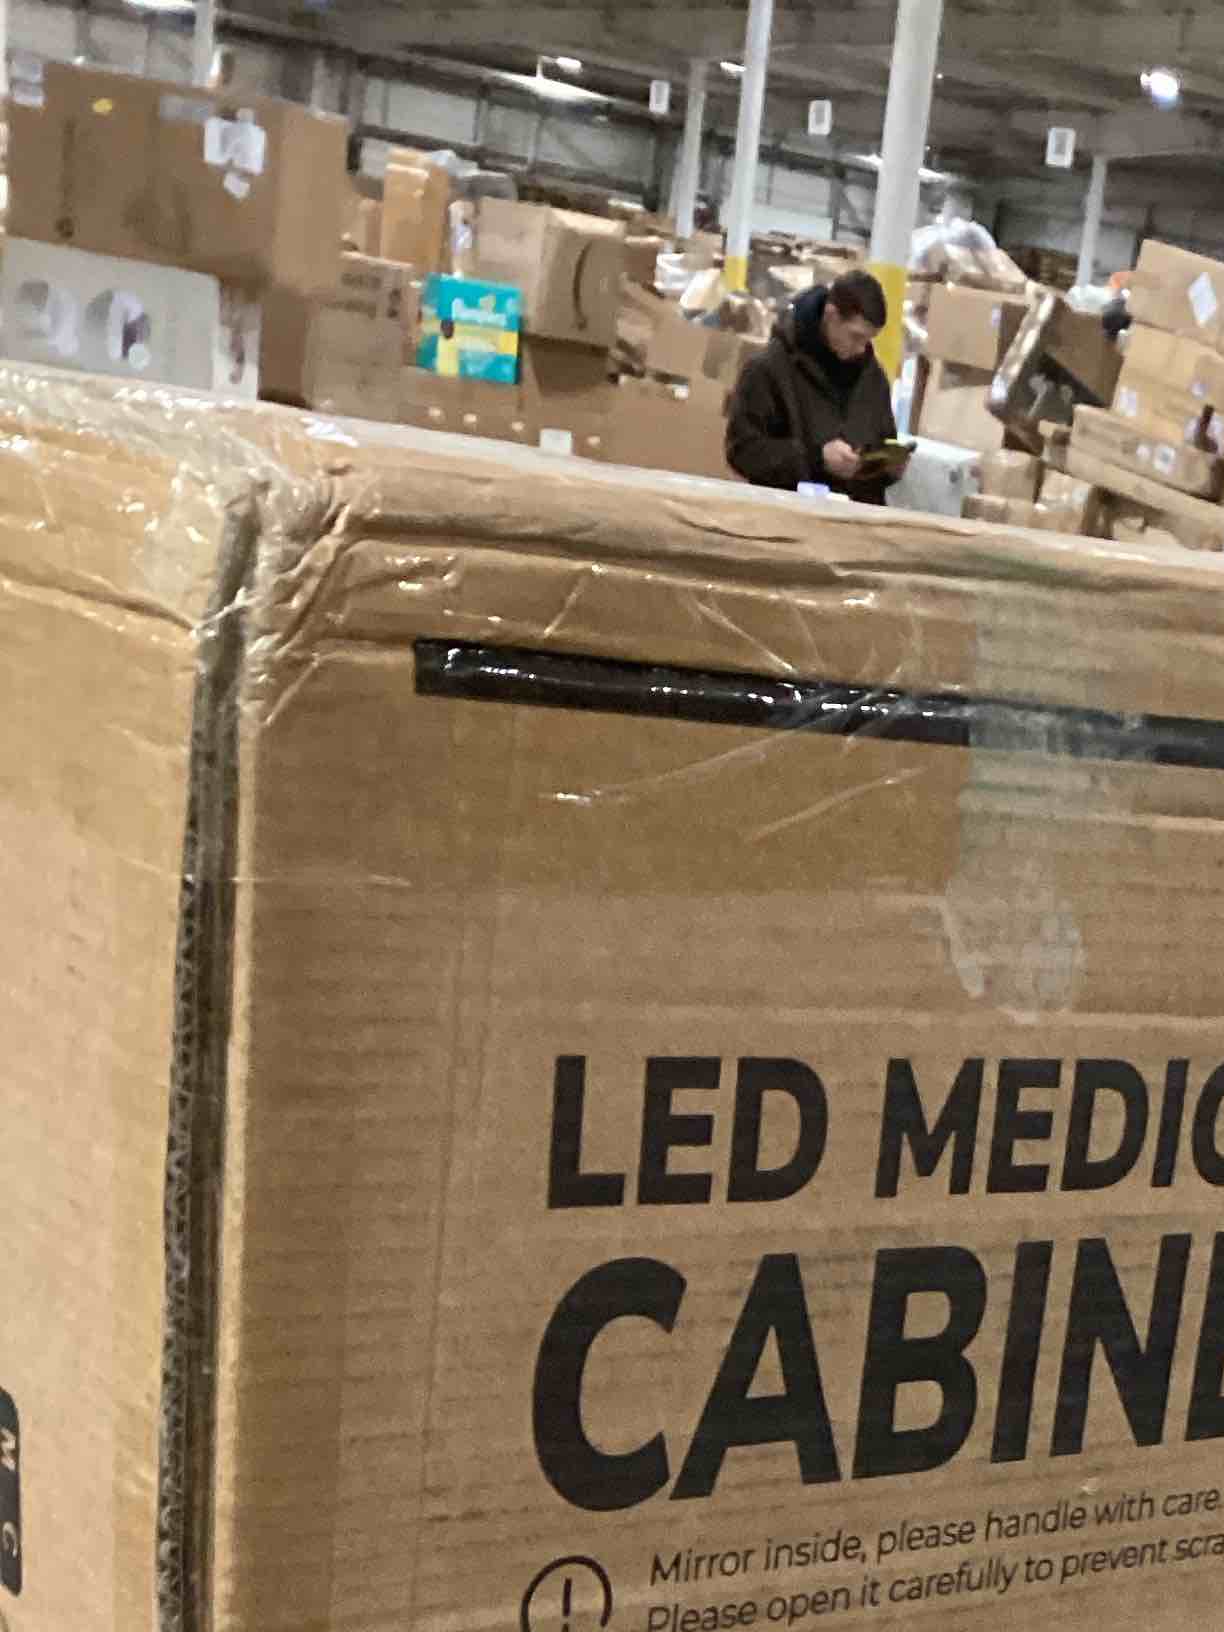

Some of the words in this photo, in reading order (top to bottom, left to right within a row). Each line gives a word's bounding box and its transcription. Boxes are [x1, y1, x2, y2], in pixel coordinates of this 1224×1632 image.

[548, 1056, 828, 1209] LED
[650, 1547, 755, 1588] Mirror
[763, 1528, 867, 1573] inside,
[876, 1517, 976, 1565] please
[984, 1500, 1087, 1543] handle
[1094, 1488, 1155, 1526] with
[767, 1585, 851, 1626] open
[861, 1574, 881, 1607] it
[889, 1558, 1018, 1603] carefully
[1024, 1556, 1054, 1584] to
[1061, 1539, 1169, 1585] prevent
